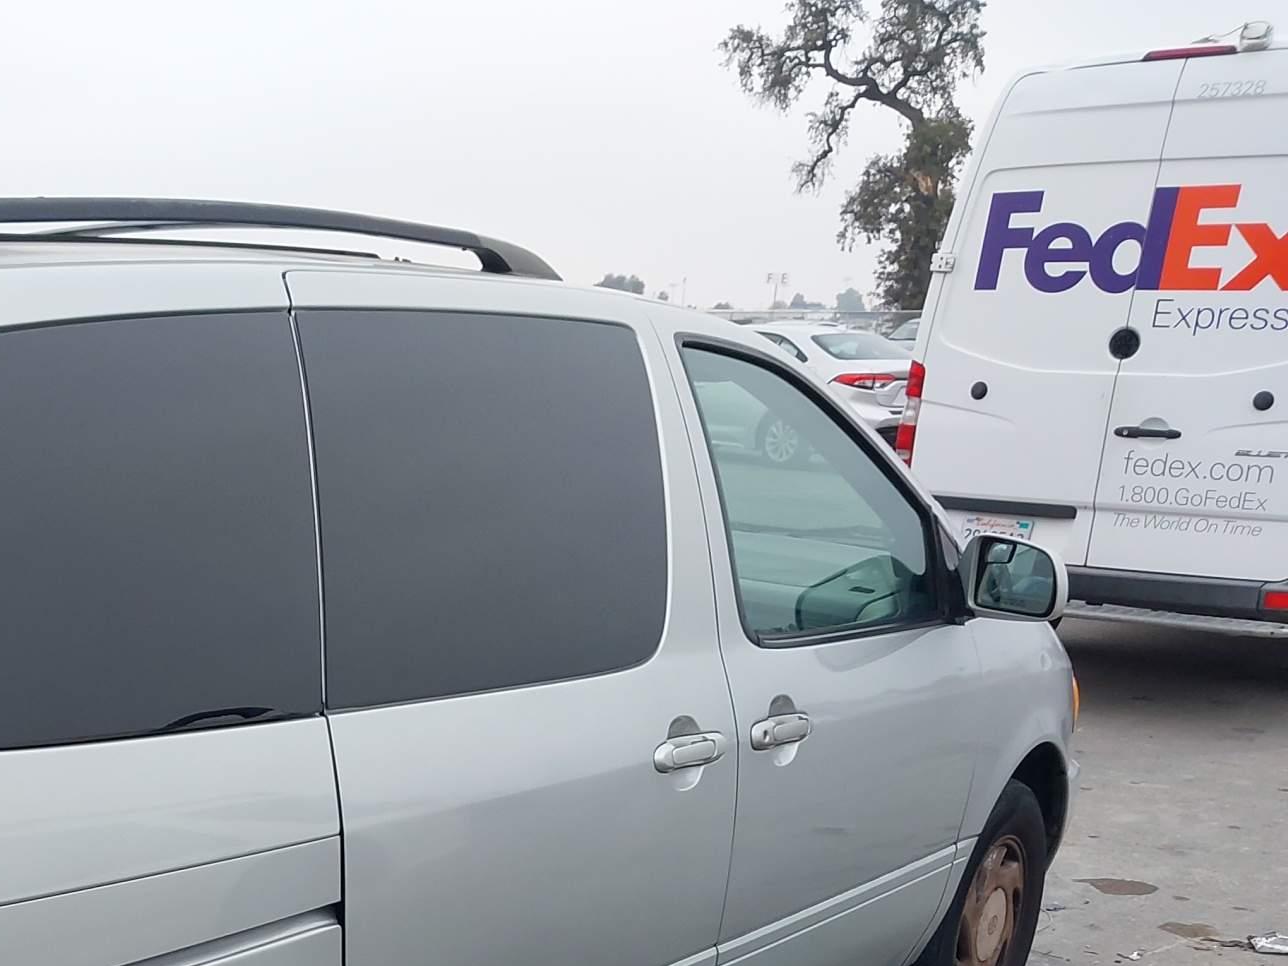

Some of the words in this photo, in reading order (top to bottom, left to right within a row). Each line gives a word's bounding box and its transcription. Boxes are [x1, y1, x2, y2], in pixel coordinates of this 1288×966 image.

[1197, 79, 1266, 98] 257328
[974, 184, 1288, 294] FedEx
[1152, 299, 1288, 336] Express
[1123, 449, 1275, 484] fedex.com
[1118, 485, 1268, 511] 1.800.GoFedEx
[1113, 512, 1140, 528] The
[1143, 515, 1192, 532] World
[1193, 518, 1219, 534] On
[1222, 519, 1263, 537] Time
